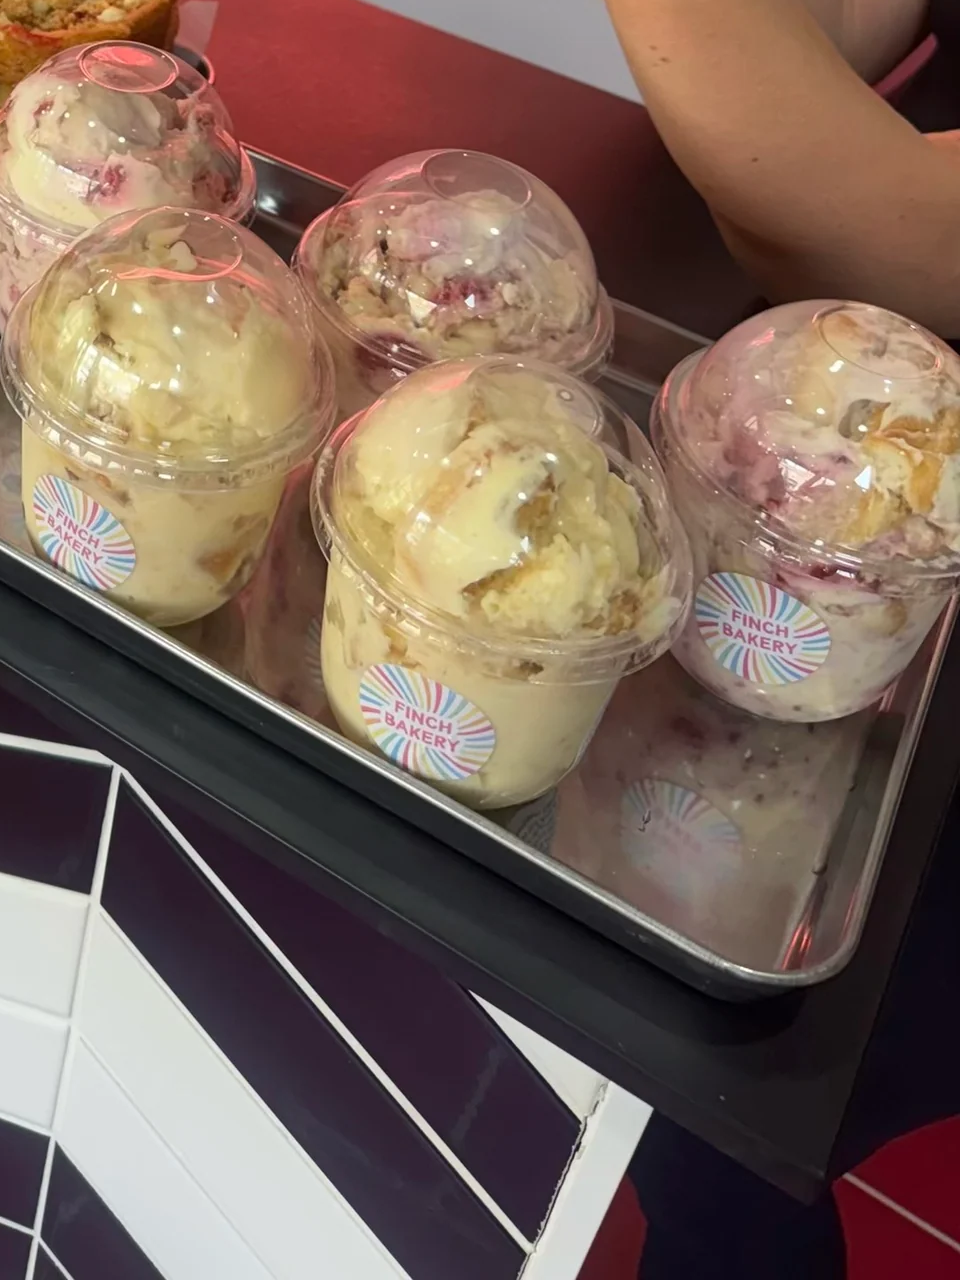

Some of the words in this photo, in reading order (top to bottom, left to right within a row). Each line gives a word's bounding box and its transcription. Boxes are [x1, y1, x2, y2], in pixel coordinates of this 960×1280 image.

[47, 514, 104, 564] BAKERY
[55, 507, 101, 549] FINCH
[721, 622, 798, 655] BAKERY
[730, 608, 789, 639] FINCH
[384, 711, 460, 752] BAKERY
[394, 699, 453, 735] FINCH
